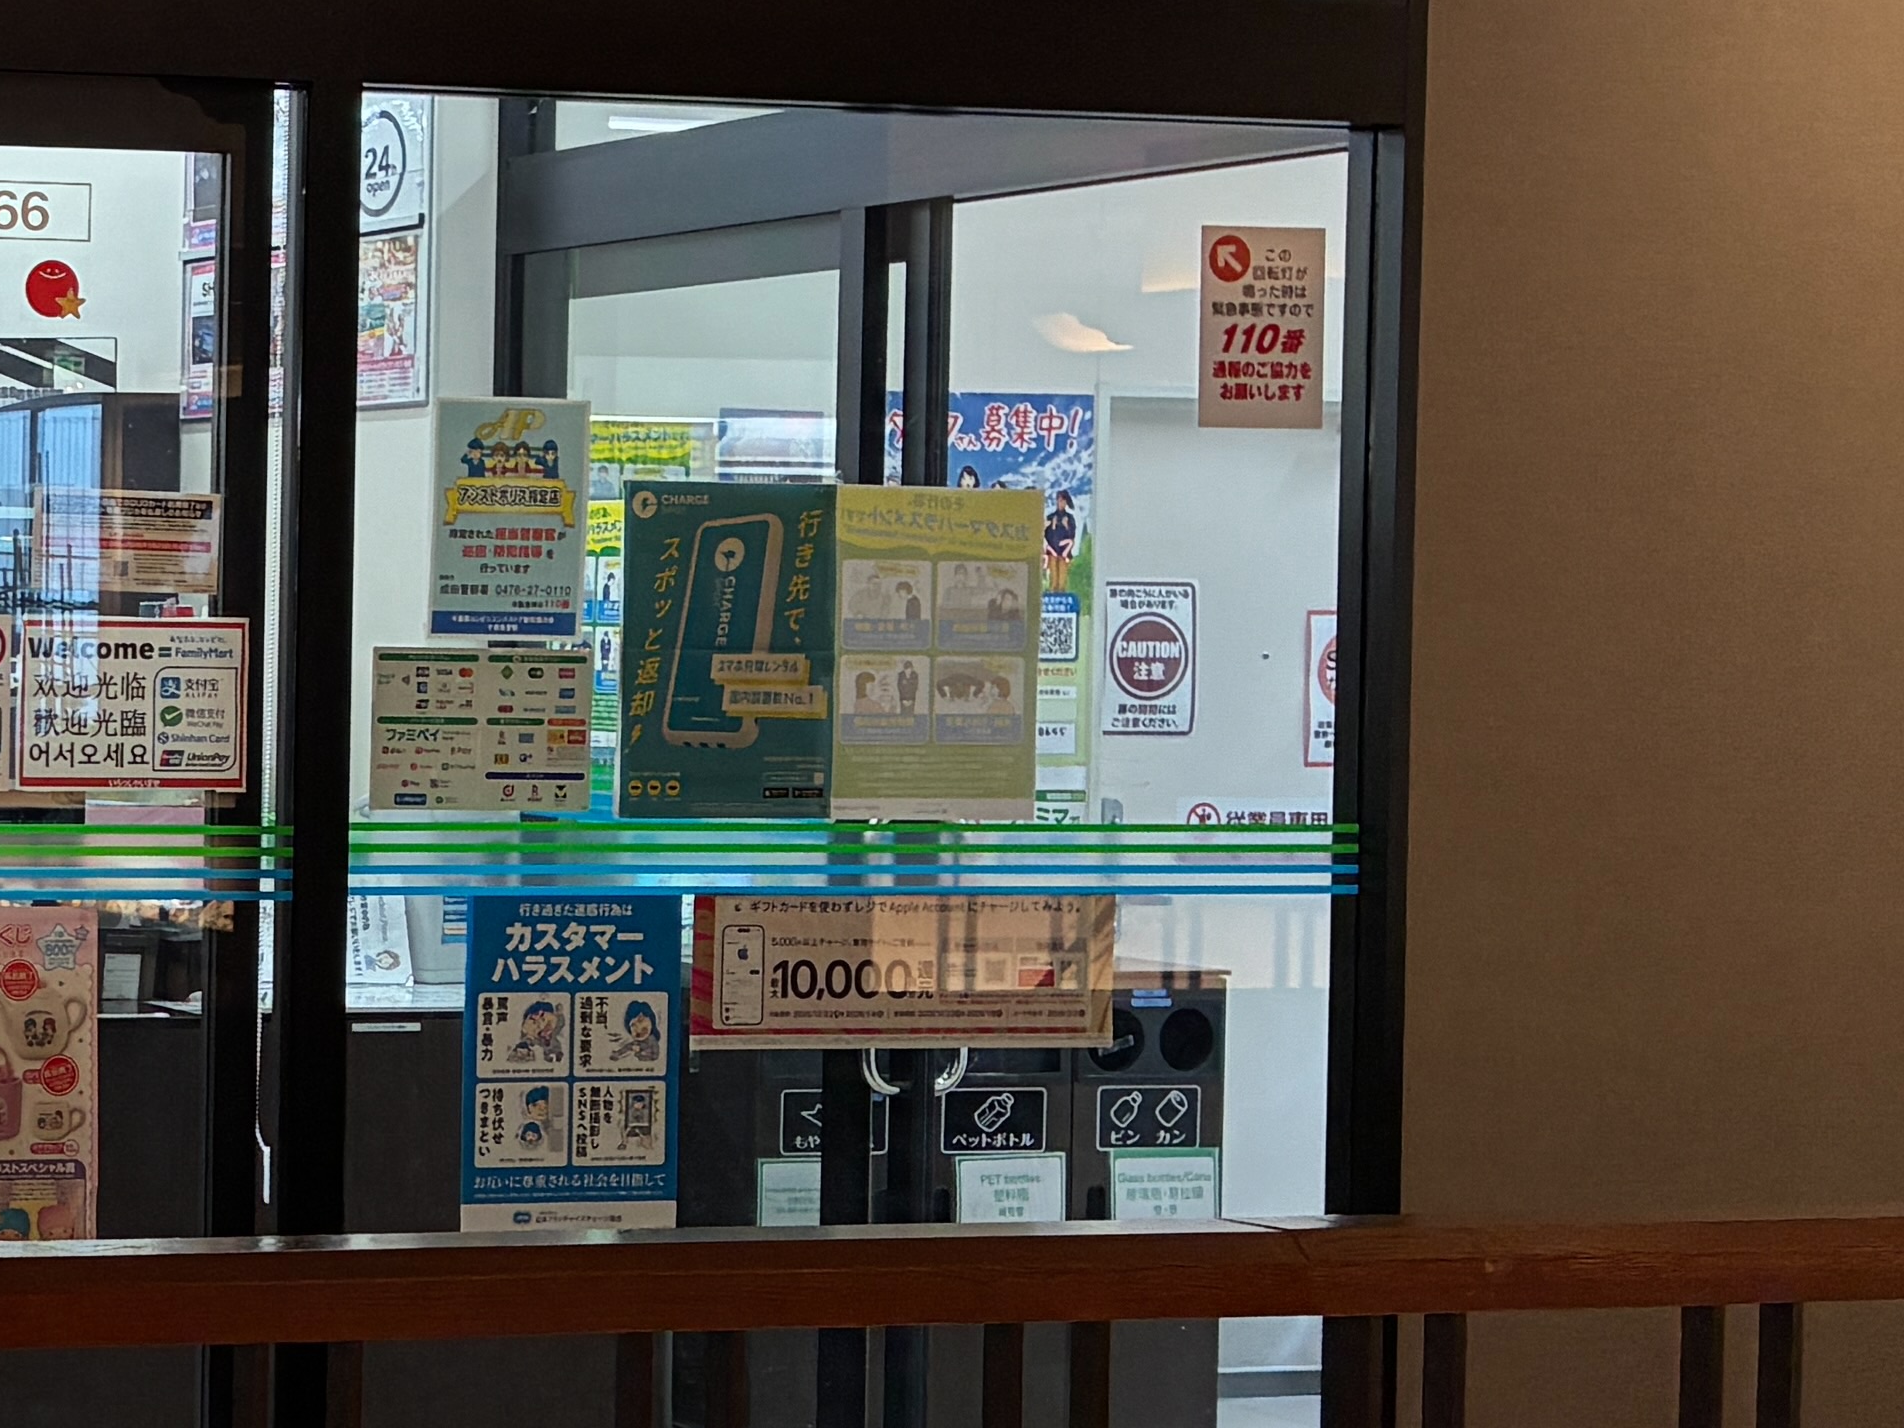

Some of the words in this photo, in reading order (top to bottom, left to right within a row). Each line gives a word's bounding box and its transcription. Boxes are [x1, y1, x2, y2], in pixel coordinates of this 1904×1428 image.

[366, 180, 391, 197] open
[1265, 248, 1291, 262] この
[1252, 265, 1308, 281] 回転灯が
[1242, 284, 1307, 299] 鳴った時は
[1212, 302, 1315, 318] 緊急事態ですので
[1222, 323, 1306, 355] 110番
[1212, 361, 1312, 380] 通報のご協力を
[1220, 382, 1306, 402] お願いします
[661, 494, 710, 506] CHARGE
[784, 509, 824, 645] 行き先で、
[715, 576, 736, 647] CHARGE
[28, 637, 154, 660] Welcome
[175, 647, 233, 660] FamilyMart
[1117, 641, 1181, 658] CAUTION
[1133, 661, 1166, 681] 注意
[33, 671, 147, 701] 欢迎光临
[185, 679, 219, 692] 支付宝
[34, 708, 147, 737] 歡迎光臨
[185, 709, 225, 720] 微信支付
[170, 734, 208, 743] Shinhan
[208, 734, 230, 743] Card
[386, 728, 440, 742] ファミペイ
[29, 741, 150, 768] 어서오세요
[890, 902, 920, 916] Apple
[505, 921, 645, 952] カスタマー
[491, 954, 654, 985] ハラスメント
[773, 959, 912, 1000] 10,000
[478, 1088, 491, 1158] つきまとい
[492, 1087, 505, 1145] 待ち伏せ
[952, 1134, 1034, 1149] ペットボトル
[1110, 1130, 1141, 1145] ビン
[1155, 1130, 1187, 1145] カン
[980, 1174, 1001, 1185] PET
[1118, 1173, 1145, 1185] Glass
